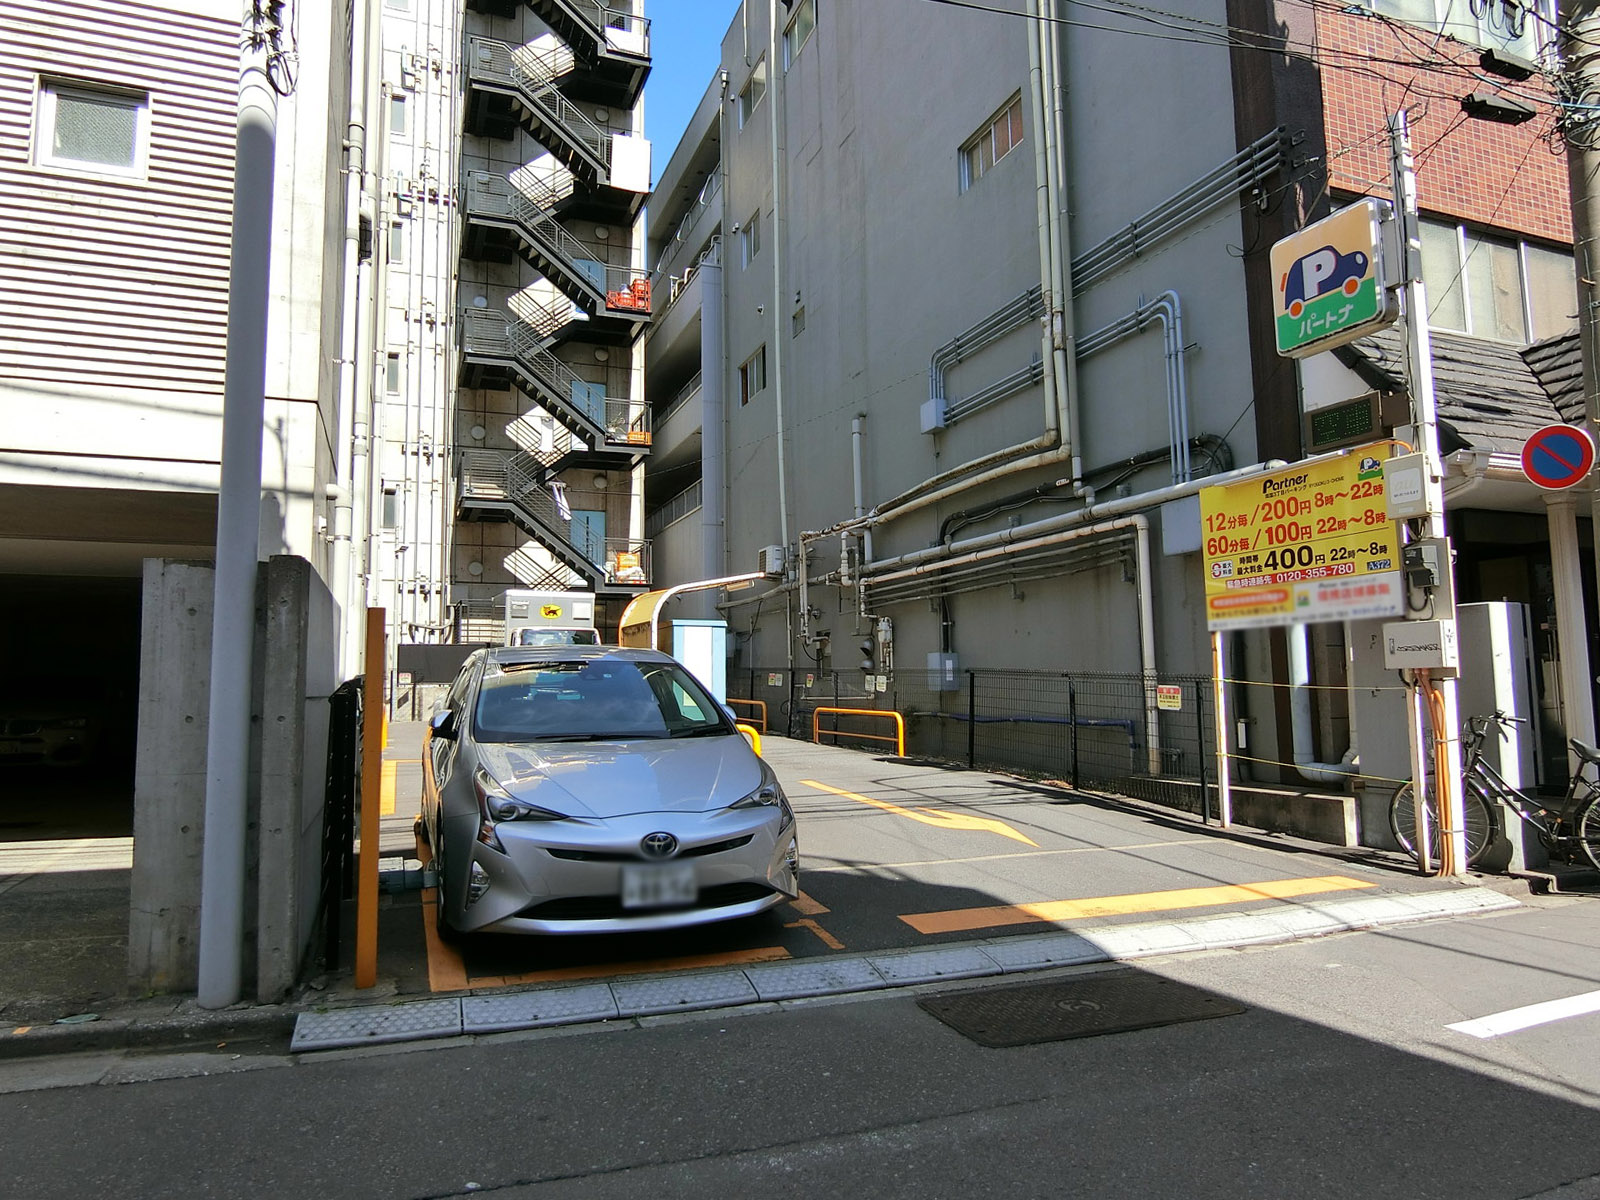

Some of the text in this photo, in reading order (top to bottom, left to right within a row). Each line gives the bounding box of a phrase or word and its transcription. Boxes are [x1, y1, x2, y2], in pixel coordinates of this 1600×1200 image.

[1302, 249, 1337, 300] P
[1299, 303, 1354, 338] パートナ
[1314, 403, 1372, 445] 空車
[1262, 473, 1309, 494] Partner
[1237, 563, 1263, 576] 最大料金
[1239, 554, 1259, 565] 時間帯
[1264, 545, 1326, 571] 400円
[1276, 563, 1354, 584] 0120-355-780
